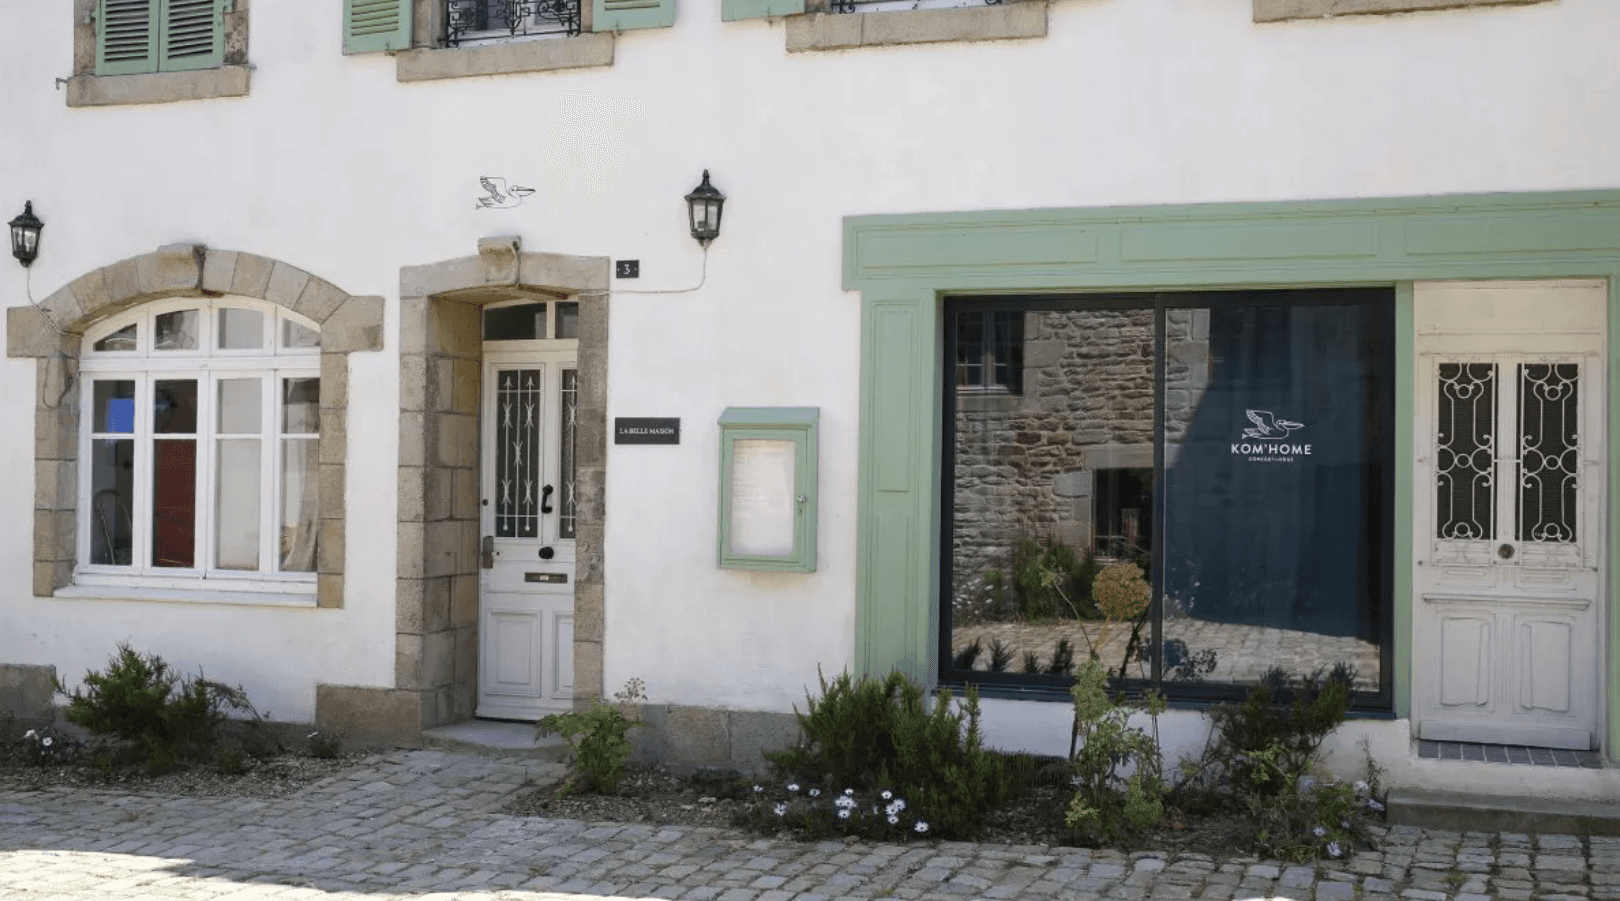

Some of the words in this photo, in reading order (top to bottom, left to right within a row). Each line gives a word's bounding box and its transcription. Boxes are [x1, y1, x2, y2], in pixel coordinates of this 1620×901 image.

[623, 263, 631, 275] 3
[619, 427, 628, 435] LA
[649, 427, 675, 435] MAISON
[1230, 443, 1312, 455] KOM'HOME
